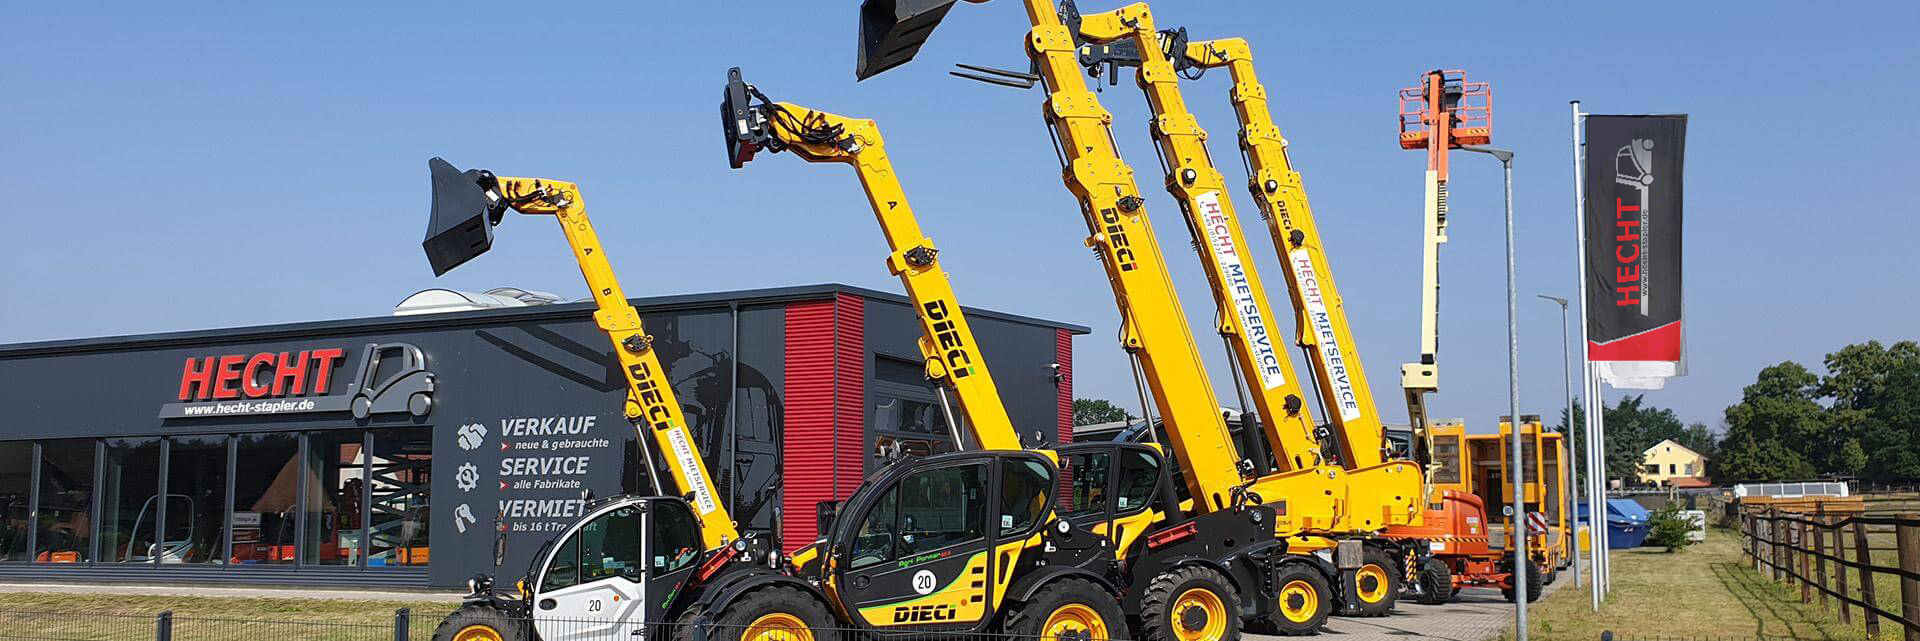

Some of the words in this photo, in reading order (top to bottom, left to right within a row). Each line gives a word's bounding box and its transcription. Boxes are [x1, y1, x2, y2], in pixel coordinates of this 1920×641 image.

[1616, 198, 1640, 306] HECHT
[1206, 203, 1236, 257] HECHT
[1228, 264, 1280, 375] MIETSERVICE
[1299, 259, 1322, 306] HECHT
[1315, 312, 1357, 409] MIETSERVICE
[178, 347, 343, 401] HECHT
[184, 399, 315, 416] www.hecht-stapler.de
[501, 415, 597, 437] VERKAUF
[515, 440, 539, 450] neue
[541, 439, 549, 449] &
[552, 438, 609, 451] gebrauchte
[500, 456, 590, 476] SERVICE
[513, 479, 531, 490] alle
[534, 479, 581, 489] Fabrikate
[500, 499, 630, 518] VERMIET
[513, 522, 527, 532] bis
[529, 522, 542, 531] 16
[918, 575, 931, 589] 20
[588, 599, 602, 612] 20
[894, 604, 957, 624] DIECI
